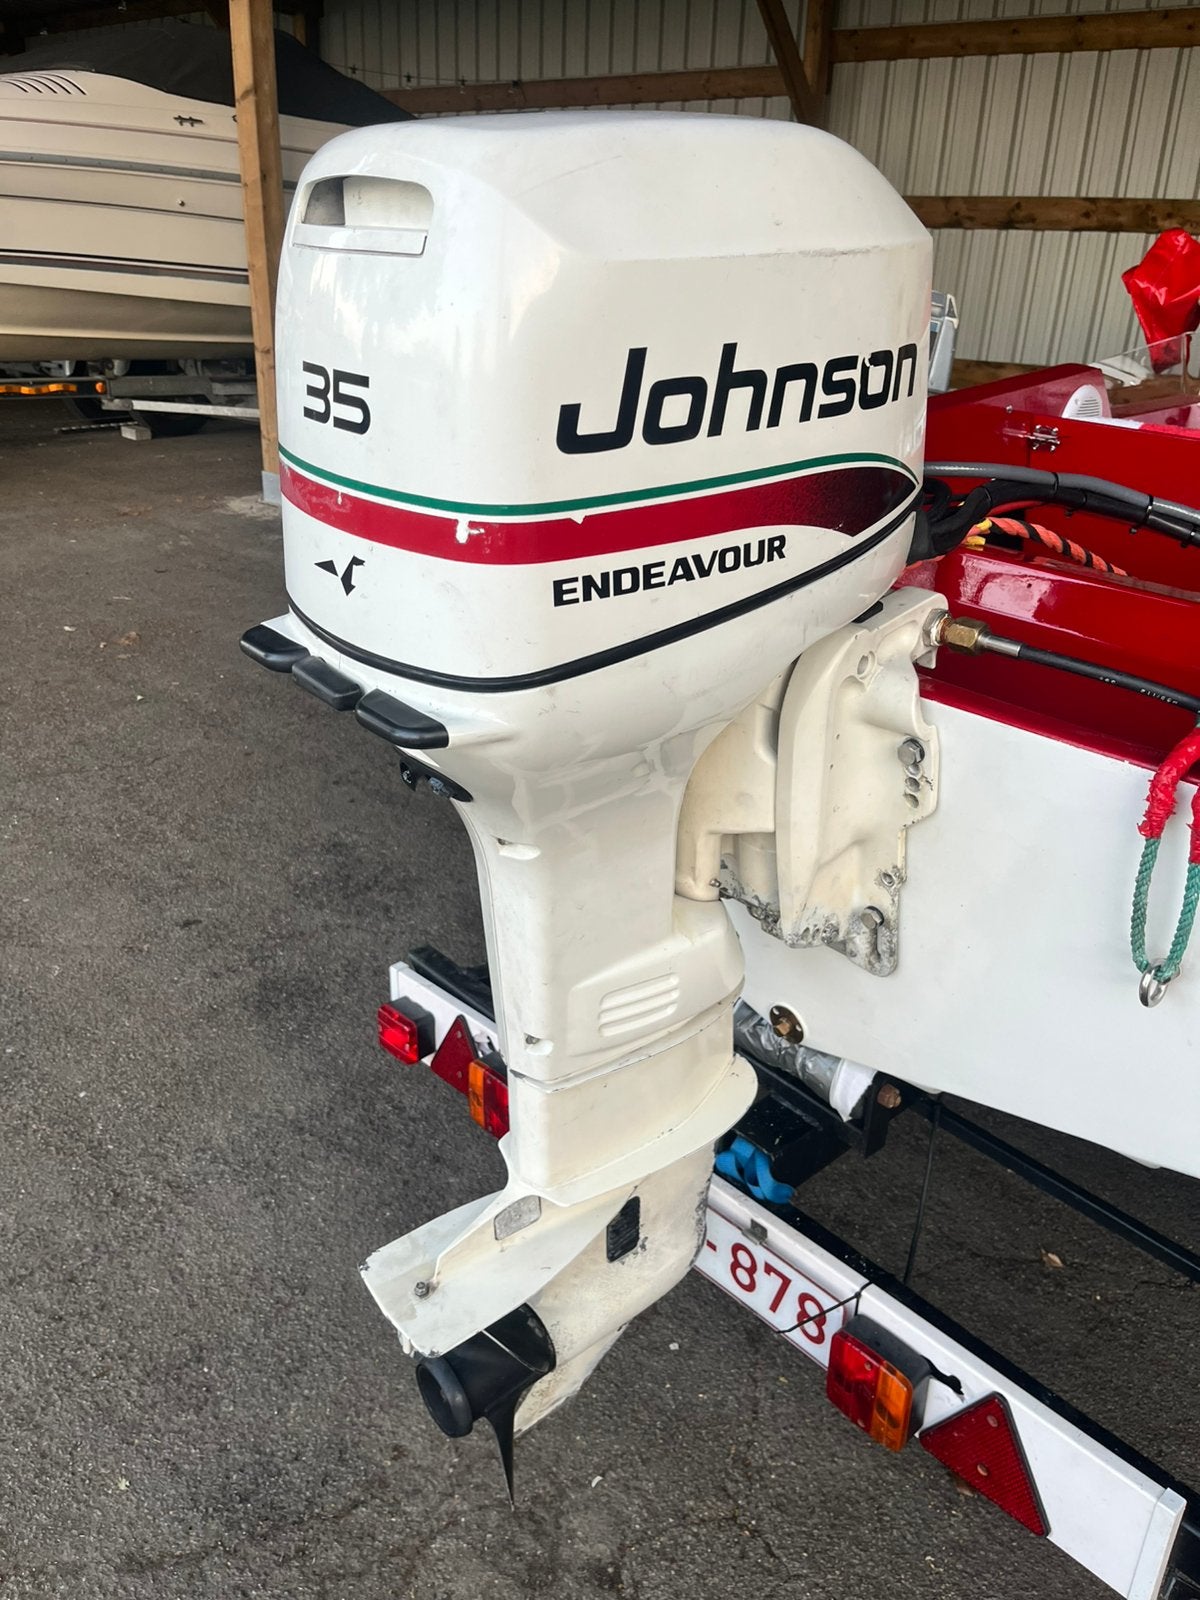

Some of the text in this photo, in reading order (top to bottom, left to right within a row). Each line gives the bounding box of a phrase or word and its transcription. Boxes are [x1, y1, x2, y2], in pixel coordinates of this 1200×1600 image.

[303, 360, 371, 435] 35
[556, 342, 917, 454] Johnson
[552, 534, 787, 607] ENDEAVOUR
